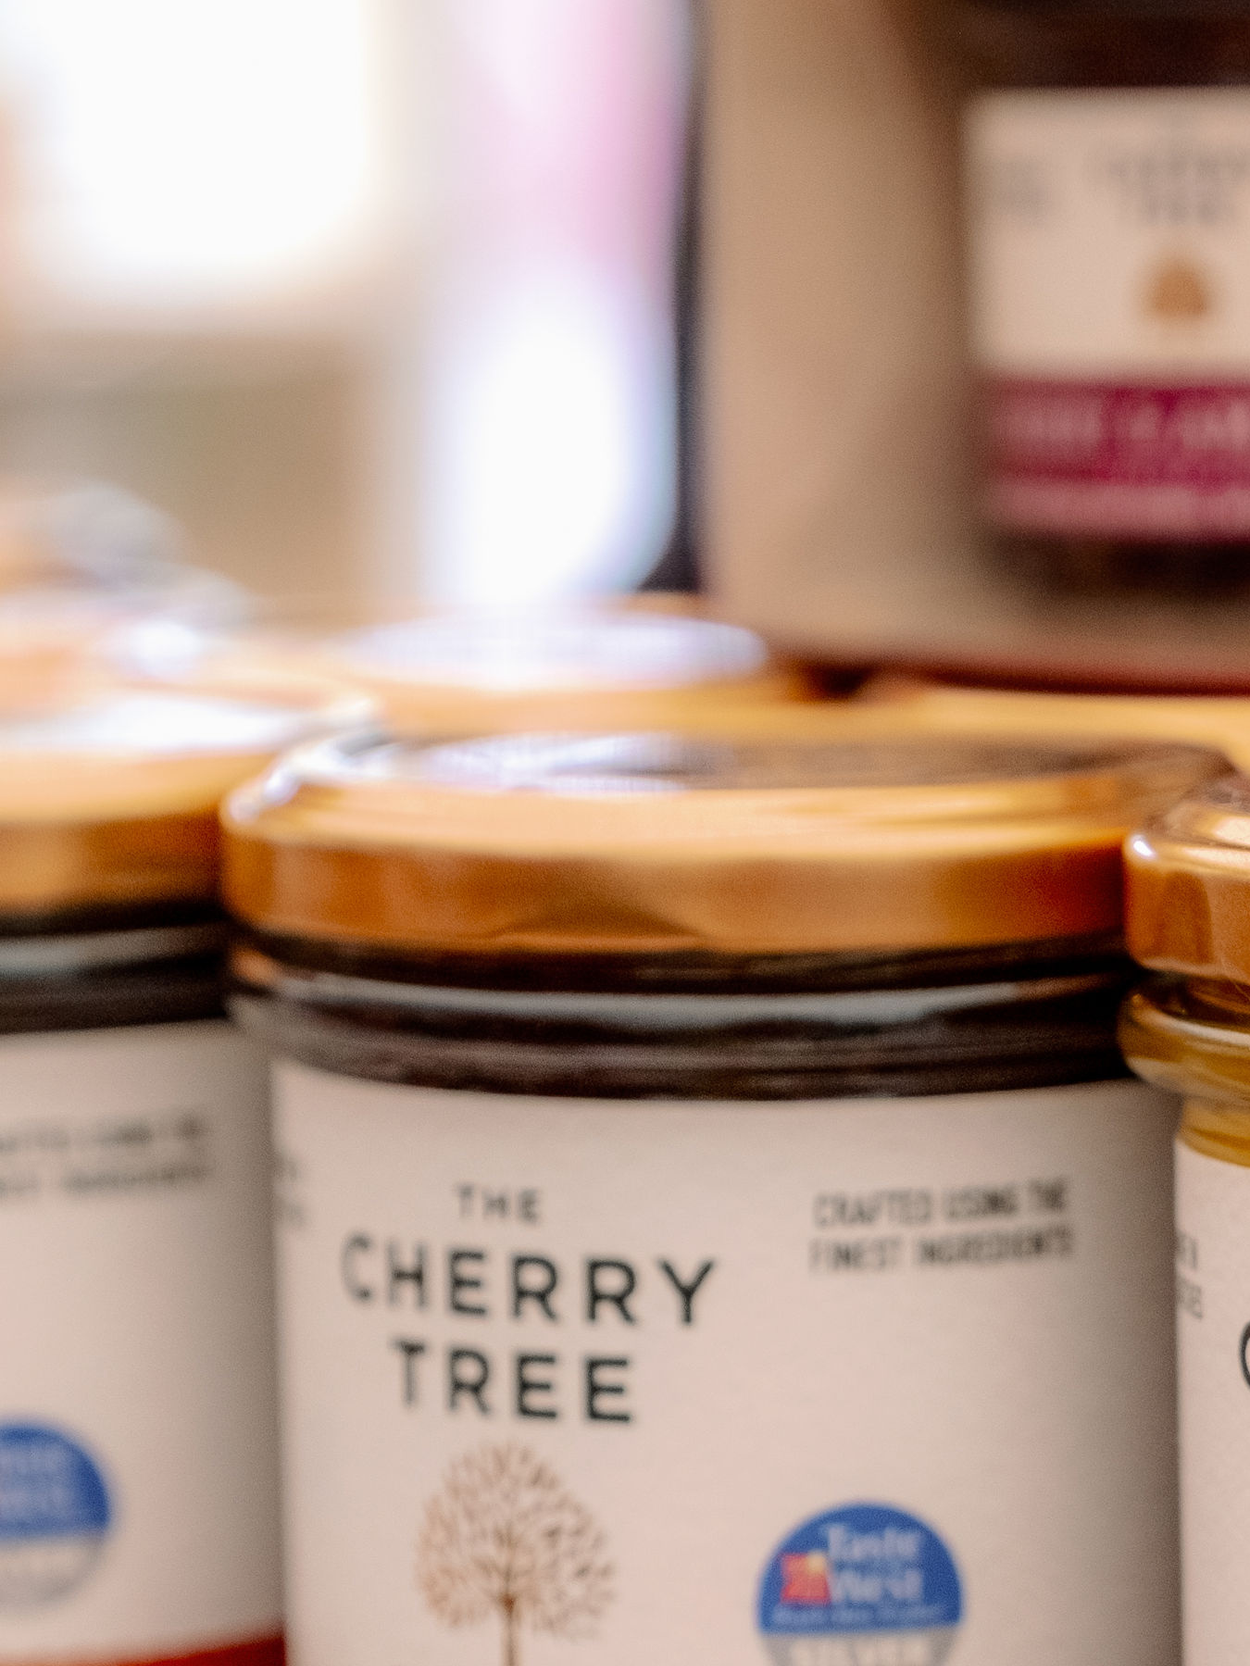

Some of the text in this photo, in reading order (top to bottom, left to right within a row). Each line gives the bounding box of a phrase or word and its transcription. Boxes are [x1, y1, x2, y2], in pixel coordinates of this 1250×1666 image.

[456, 1184, 543, 1223] THE
[341, 1231, 717, 1327] CHERRY
[391, 1337, 636, 1426] TREE
